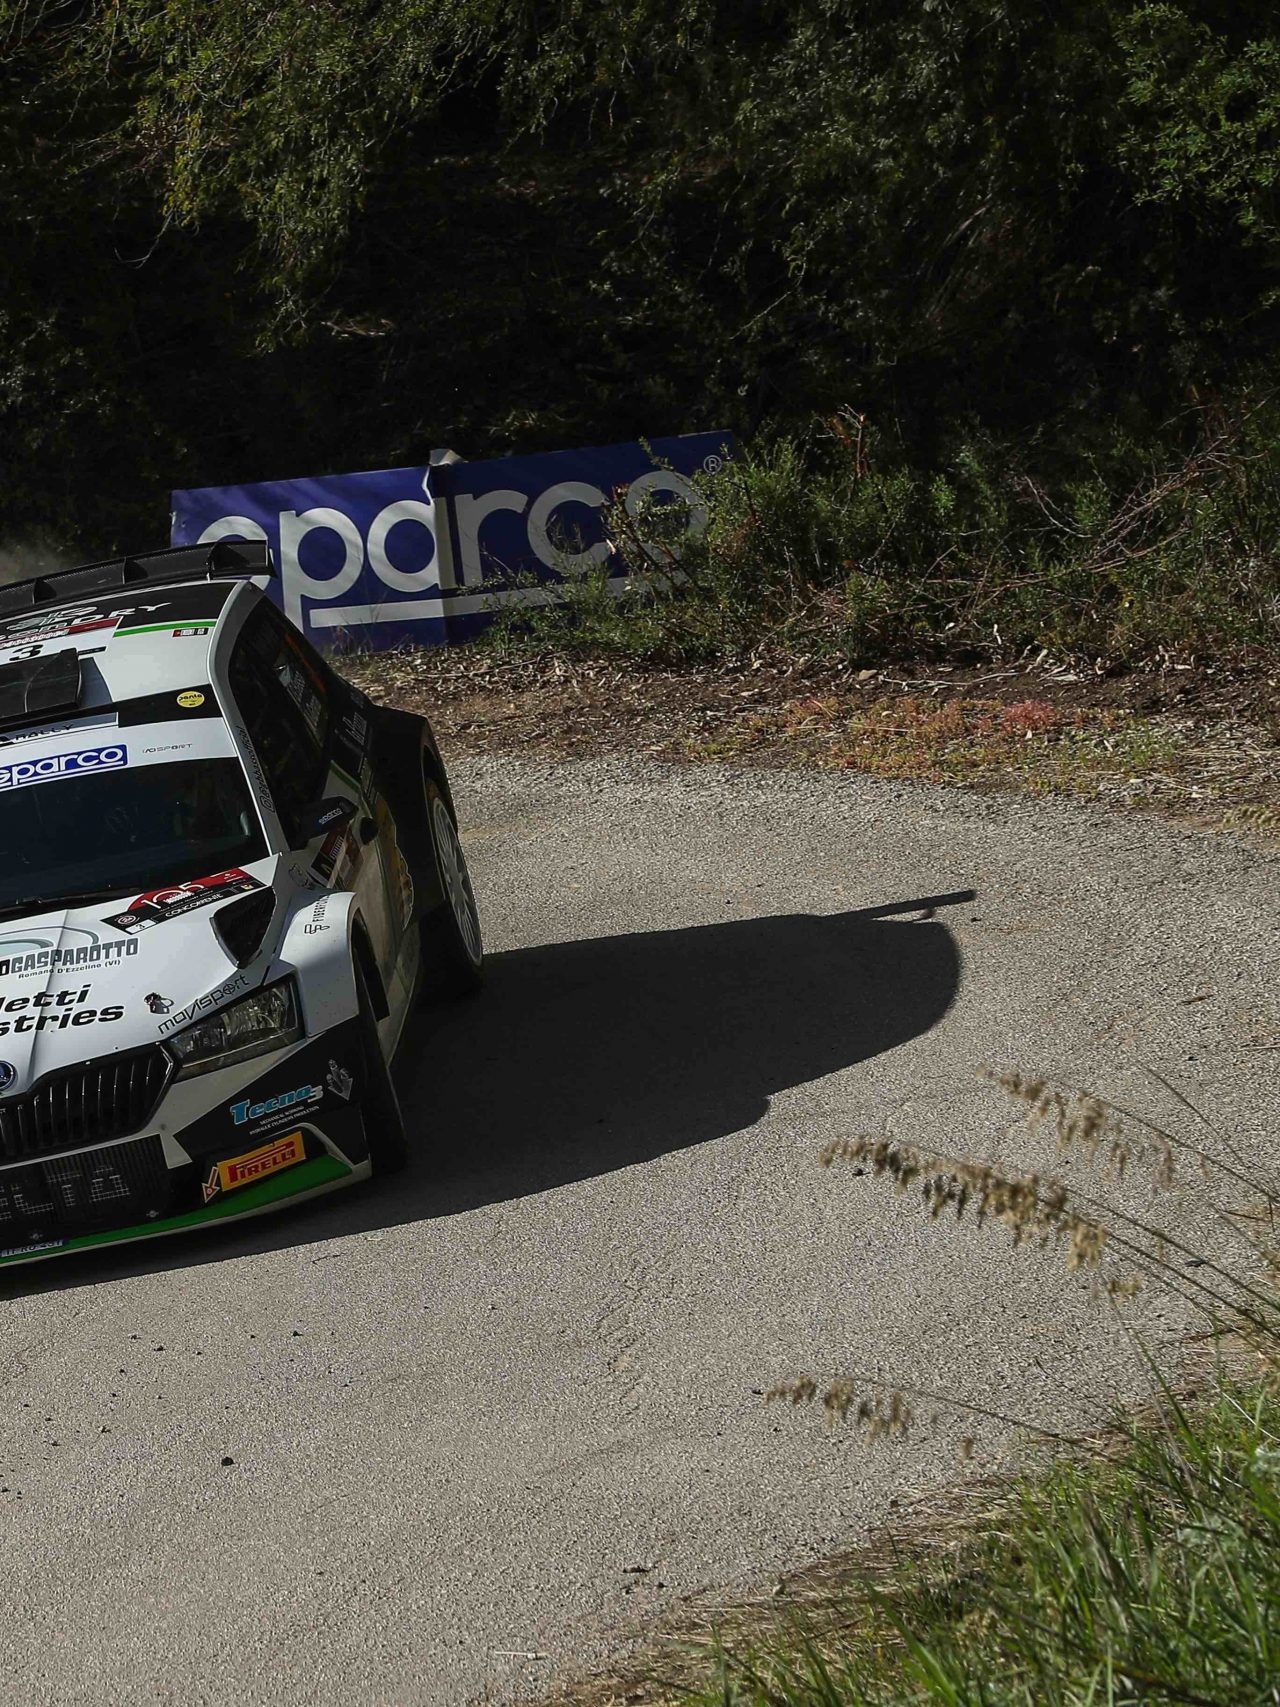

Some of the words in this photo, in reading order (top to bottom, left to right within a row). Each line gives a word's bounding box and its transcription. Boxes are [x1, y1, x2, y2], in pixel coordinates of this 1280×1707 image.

[9, 644, 44, 662] 3
[18, 968, 55, 980] Romano
[57, 962, 102, 975] D'Ezzelino
[104, 959, 122, 969] (VI)
[227, 1140, 296, 1183] PIRELLI
